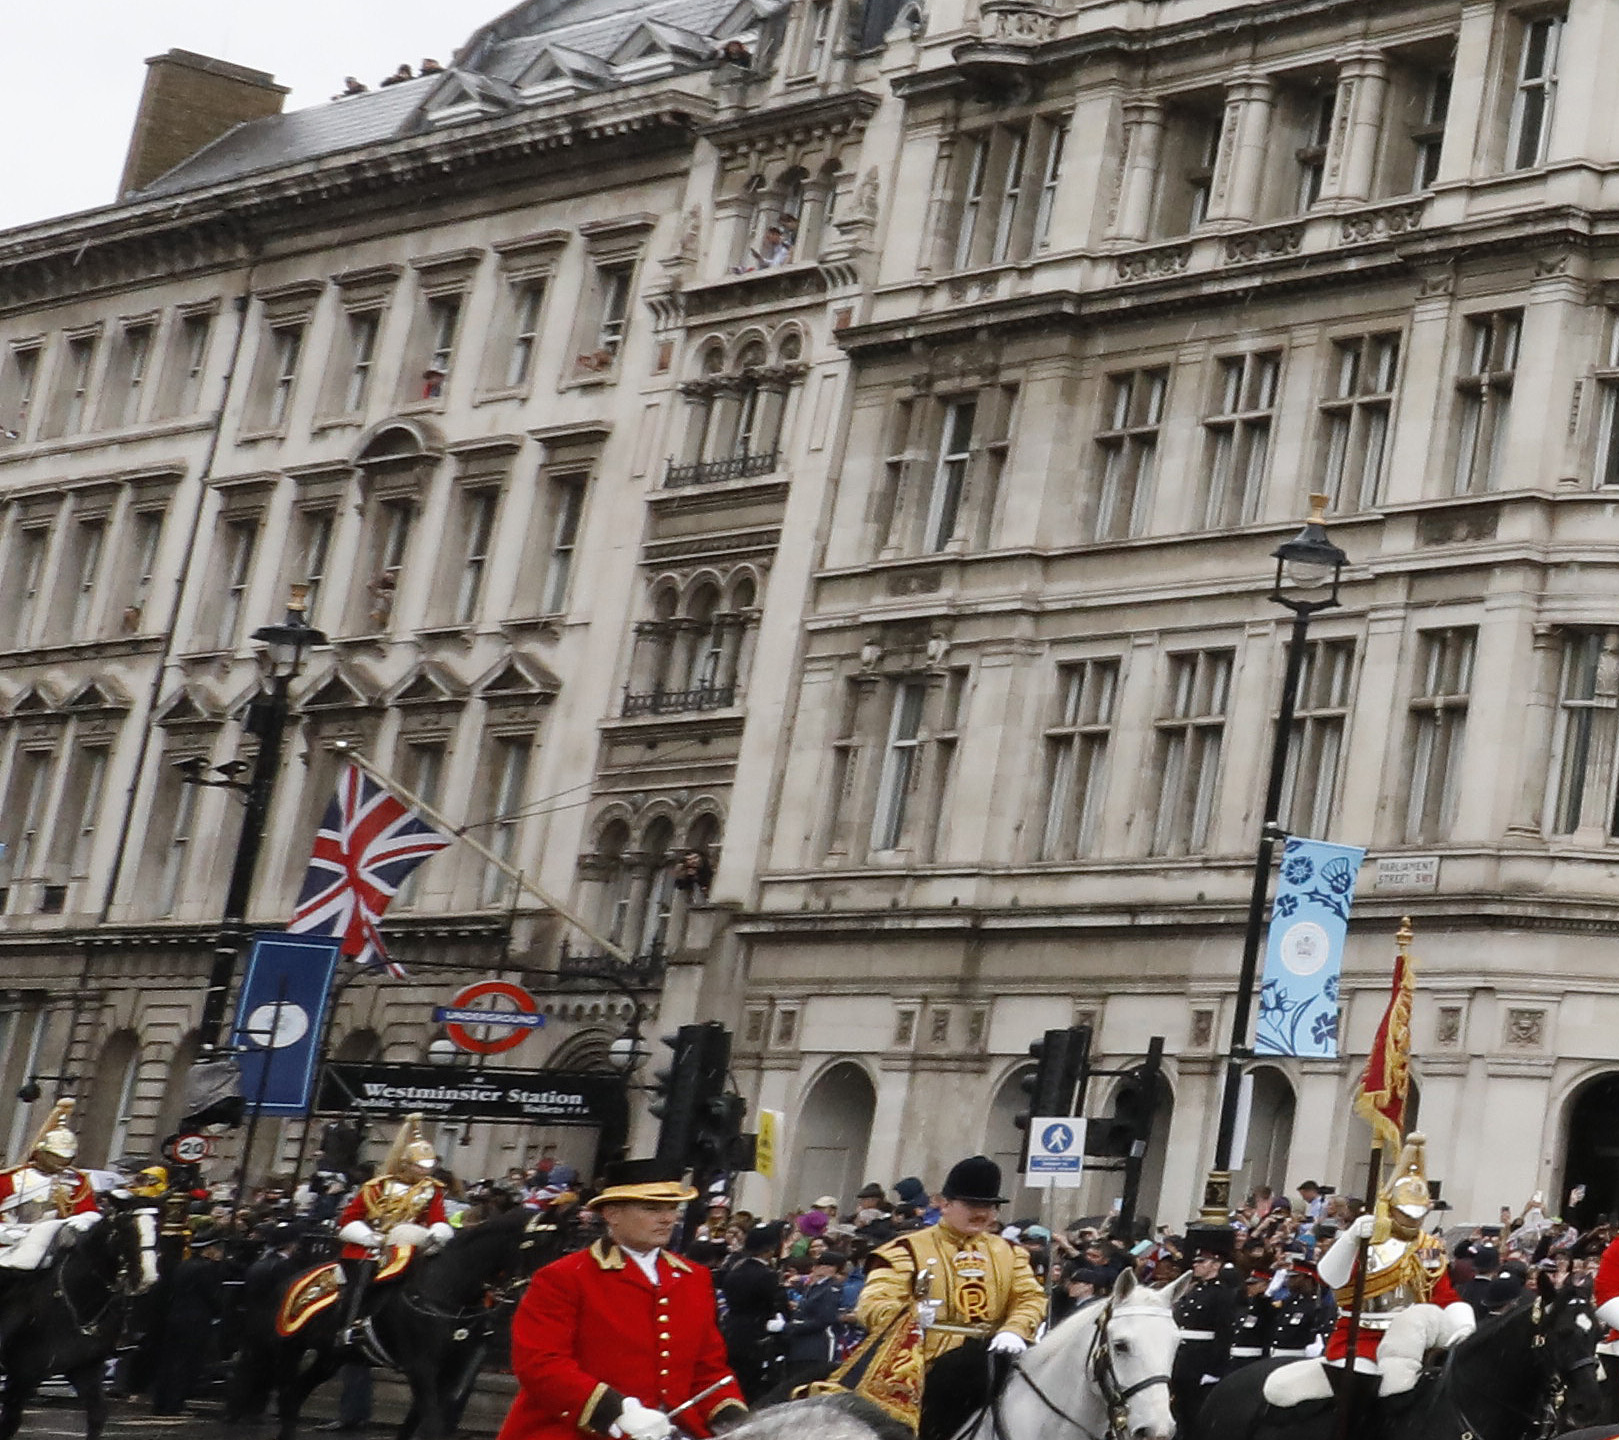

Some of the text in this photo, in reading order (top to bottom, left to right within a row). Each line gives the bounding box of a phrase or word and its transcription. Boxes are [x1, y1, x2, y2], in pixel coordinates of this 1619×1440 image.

[445, 1010, 540, 1025] UNDERGROUND
[363, 1082, 503, 1102] Westminster
[506, 1088, 583, 1104] Station
[179, 1141, 205, 1155] 20
